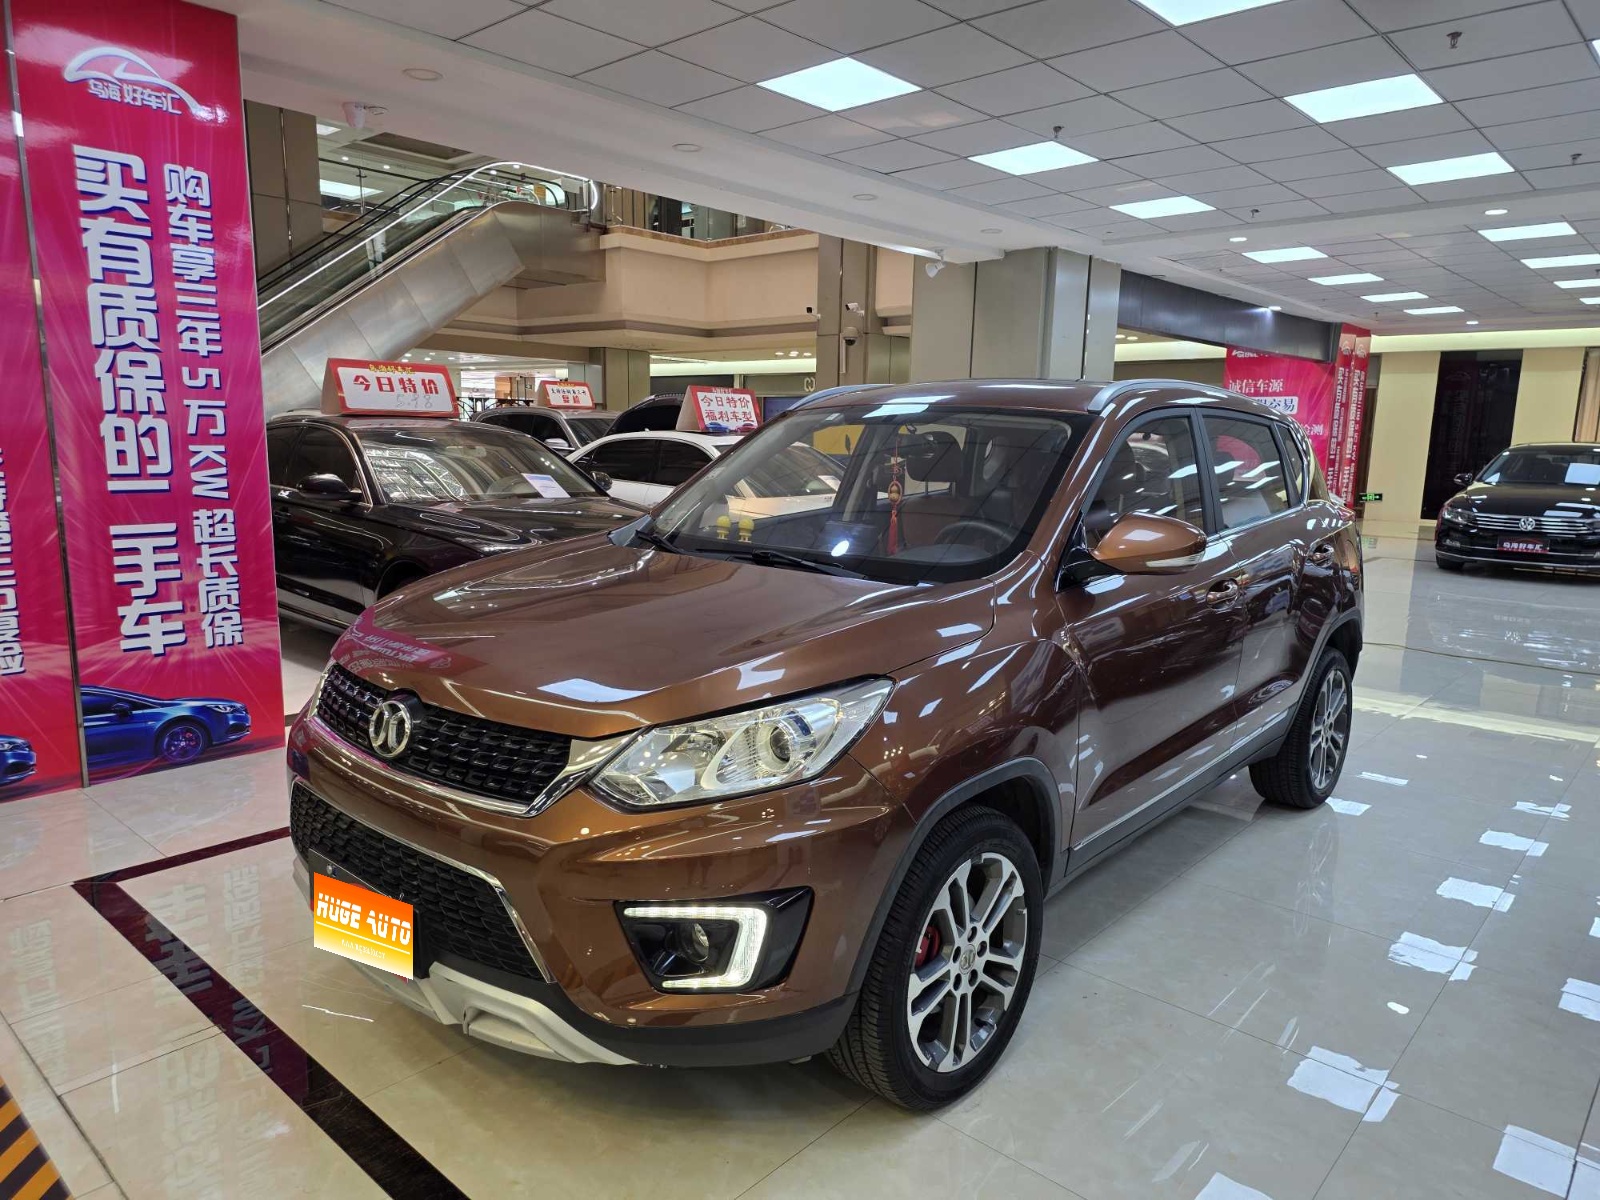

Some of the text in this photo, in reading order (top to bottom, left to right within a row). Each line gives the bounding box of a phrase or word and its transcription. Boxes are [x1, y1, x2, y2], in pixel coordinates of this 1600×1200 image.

[353, 375, 439, 395] 今日特价
[72, 144, 187, 656] 买有质保的二手车
[701, 395, 750, 409] 今日特价
[705, 409, 755, 423] 福利车型
